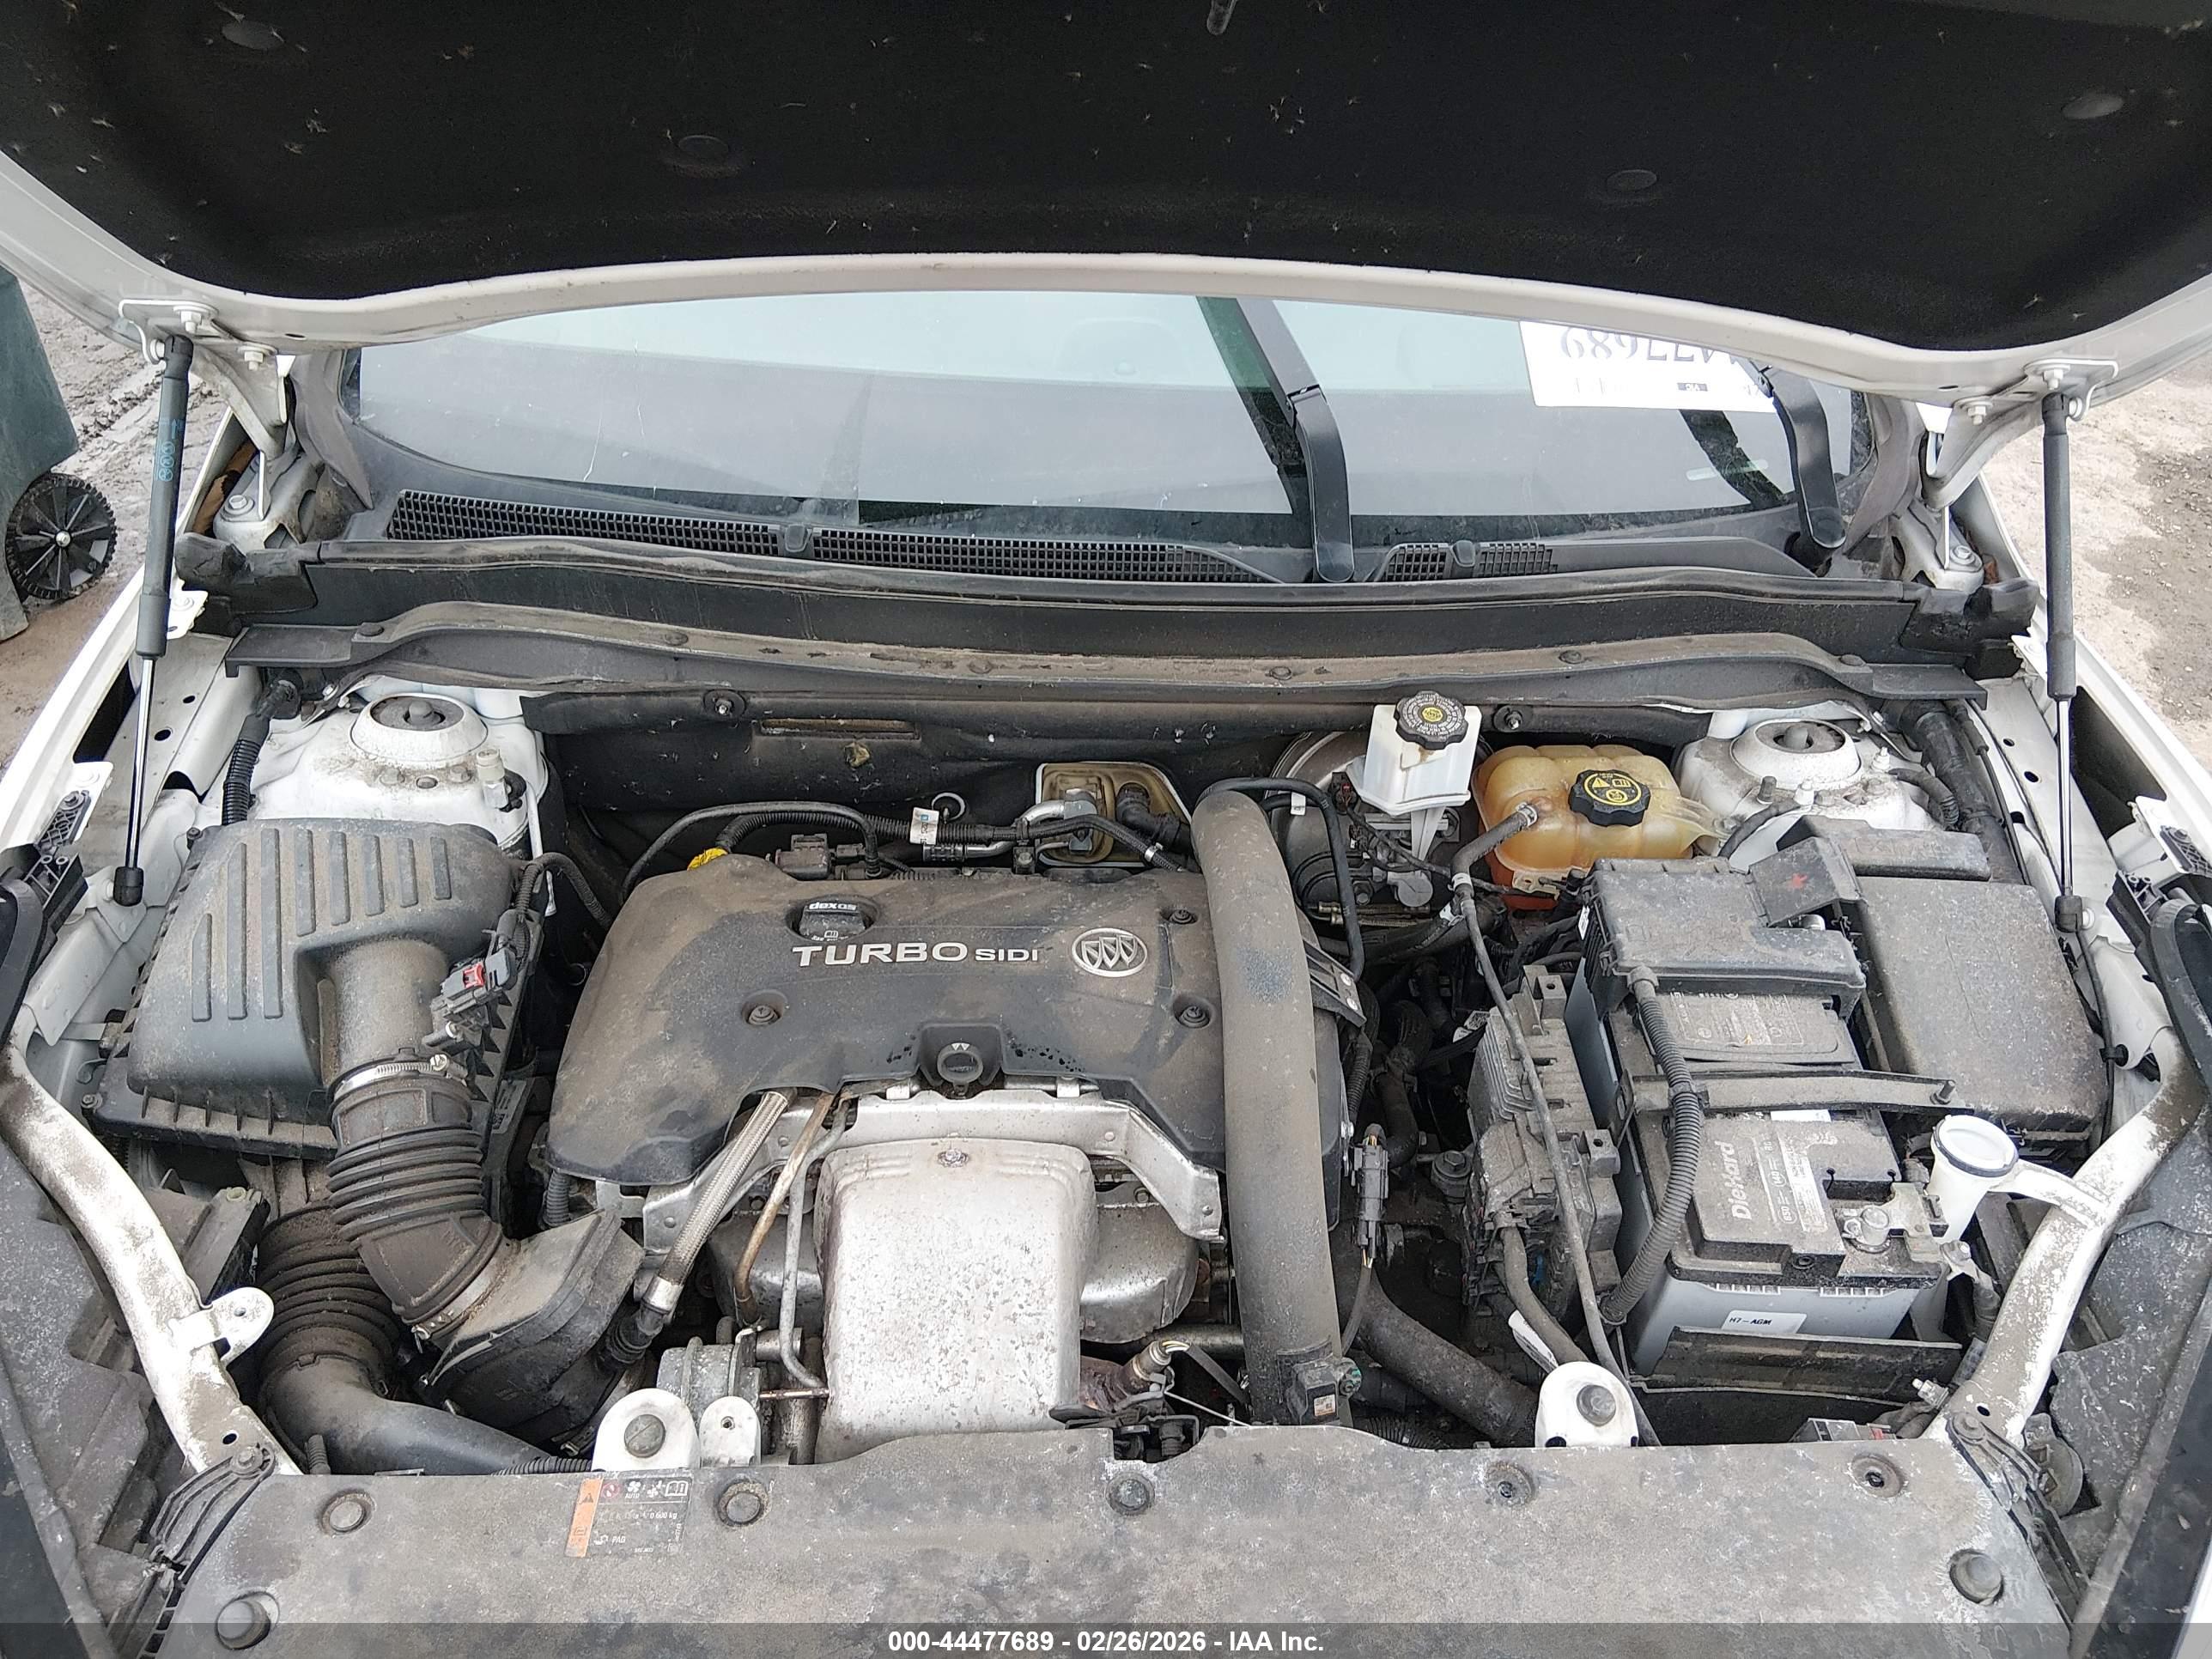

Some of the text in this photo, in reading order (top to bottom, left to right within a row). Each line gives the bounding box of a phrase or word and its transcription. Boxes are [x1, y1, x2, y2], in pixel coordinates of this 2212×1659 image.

[809, 902, 858, 911] dexos
[792, 942, 1038, 967] TURBO SIDI
[1713, 1140, 1753, 1220] DieHard
